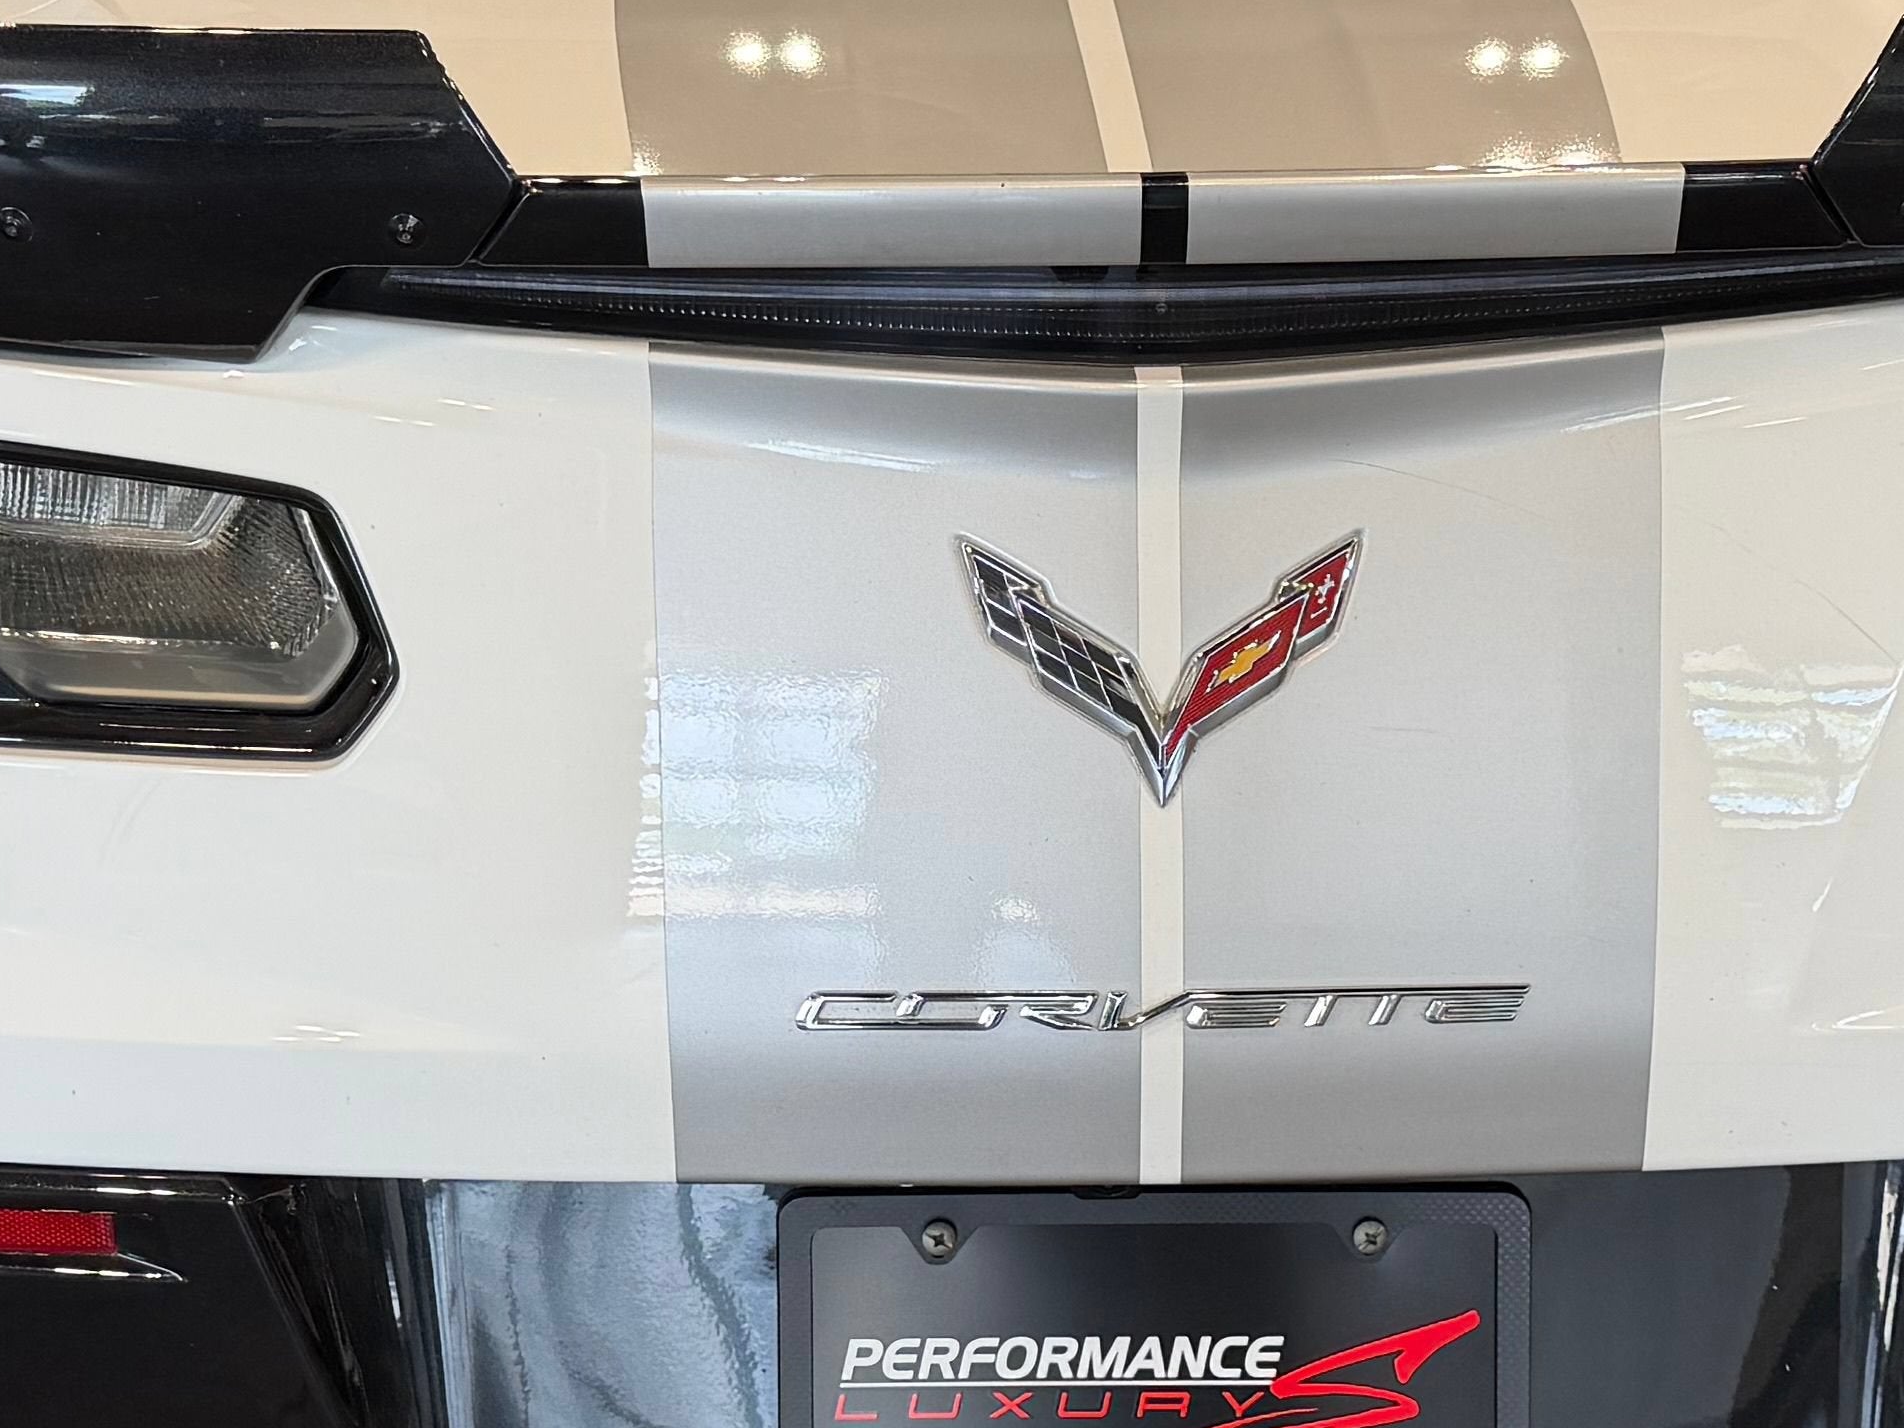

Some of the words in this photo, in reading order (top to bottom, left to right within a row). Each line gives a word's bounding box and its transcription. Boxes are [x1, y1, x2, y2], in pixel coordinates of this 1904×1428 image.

[794, 984, 1532, 1032] CORVETTE
[840, 1335, 1285, 1381] PERFORMANCE
[834, 1390, 1265, 1422] LUXURY
